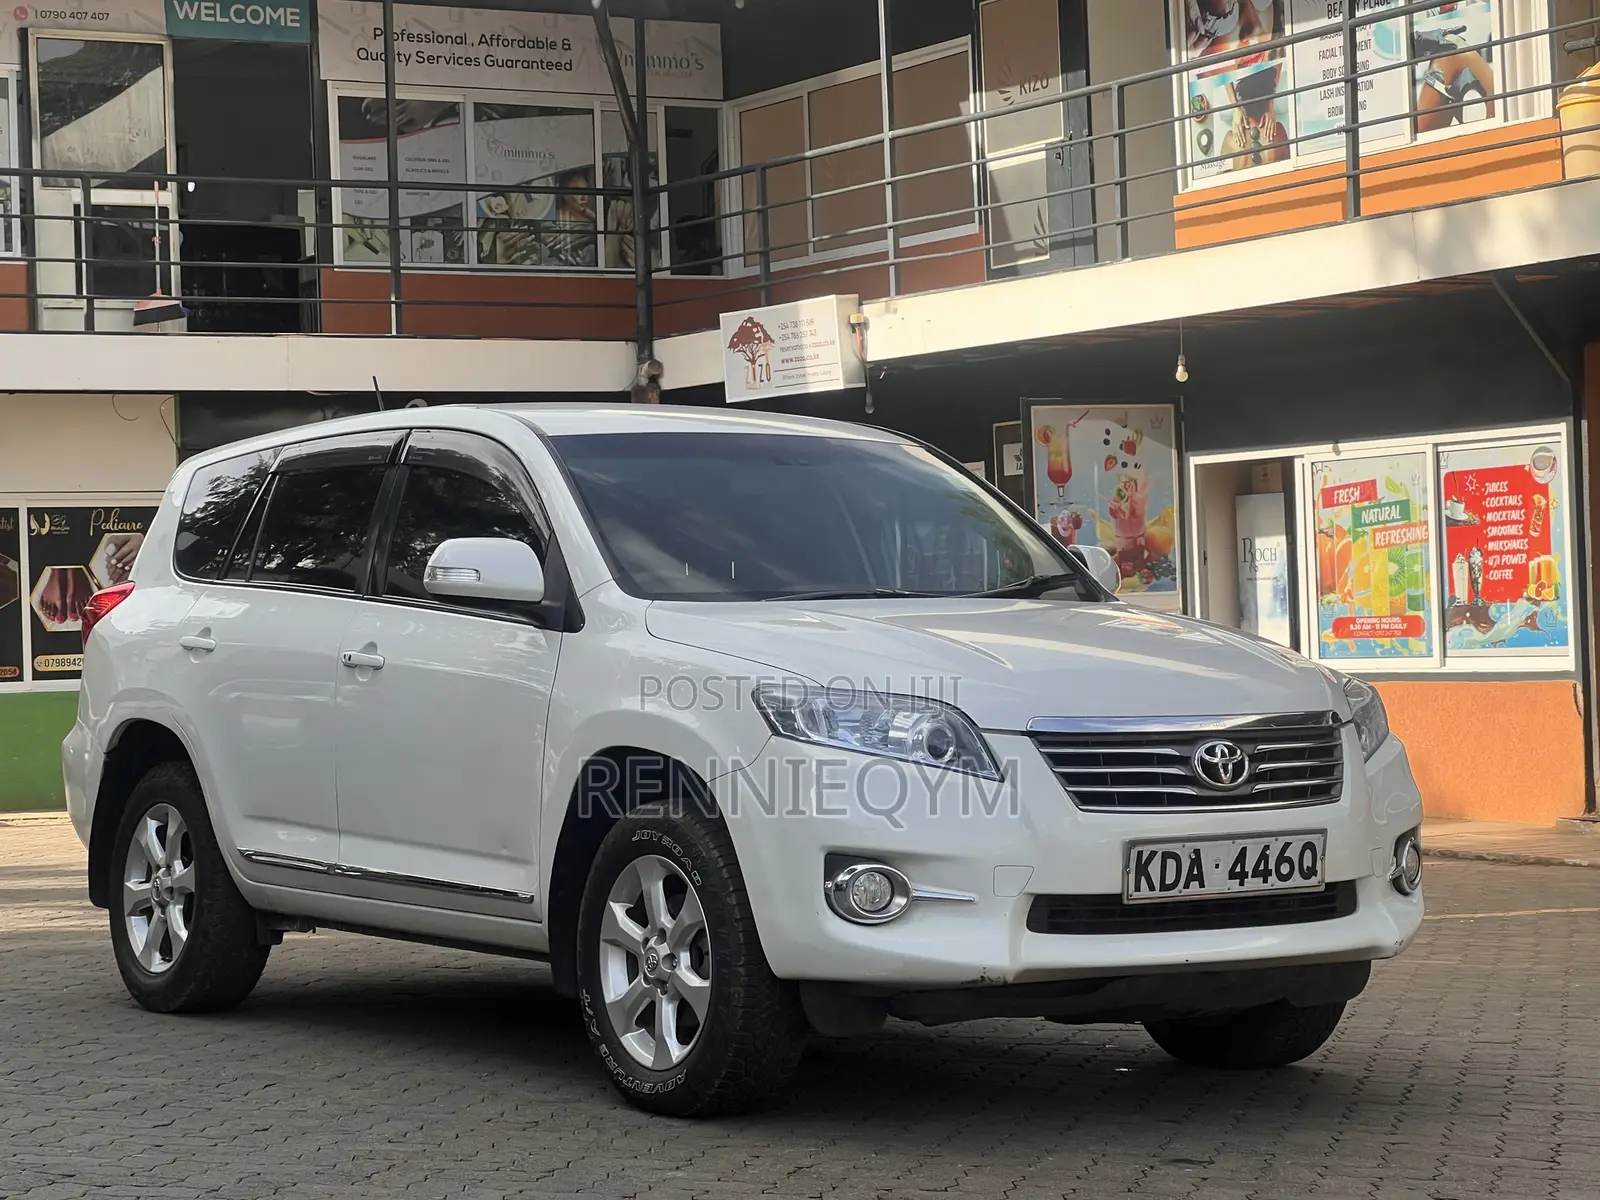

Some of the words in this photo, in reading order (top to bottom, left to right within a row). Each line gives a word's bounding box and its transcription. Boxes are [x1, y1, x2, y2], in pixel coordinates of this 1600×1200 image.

[40, 10, 67, 19] 0790
[69, 11, 88, 20] 407
[90, 12, 110, 21] 407
[173, 0, 300, 27] WELCOME
[373, 27, 467, 46] Pofessional
[478, 33, 558, 51] Affordable
[561, 38, 572, 51] &
[415, 50, 481, 67] Services
[484, 54, 573, 72] Guaranteed
[1318, 47, 1338, 61] FACIAL
[1322, 67, 1337, 80] BODY
[1019, 73, 1049, 95] KIZO
[1319, 88, 1334, 101] LASH
[1333, 485, 1360, 505] FRESH
[1484, 481, 1509, 496] JUICES
[1485, 493, 1523, 508] COCKTAILS
[90, 508, 144, 536] Pedicure
[1361, 504, 1402, 524] NATURAL
[1486, 508, 1526, 523] MOCKTAILS
[1375, 524, 1429, 547] REFRESHING
[1487, 523, 1523, 538] SMOOTHIES
[1487, 537, 1529, 552] MILKSHAKES
[1488, 554, 1500, 568] UJI
[1501, 552, 1528, 566] POWER
[1488, 568, 1515, 581] COFFEE
[44, 657, 85, 668] 0798942
[631, 829, 702, 887] JOYROAD
[1134, 848, 1206, 893] KDA
[1228, 841, 1319, 886] 446Q
[599, 1043, 687, 1094] ADVENTURE
